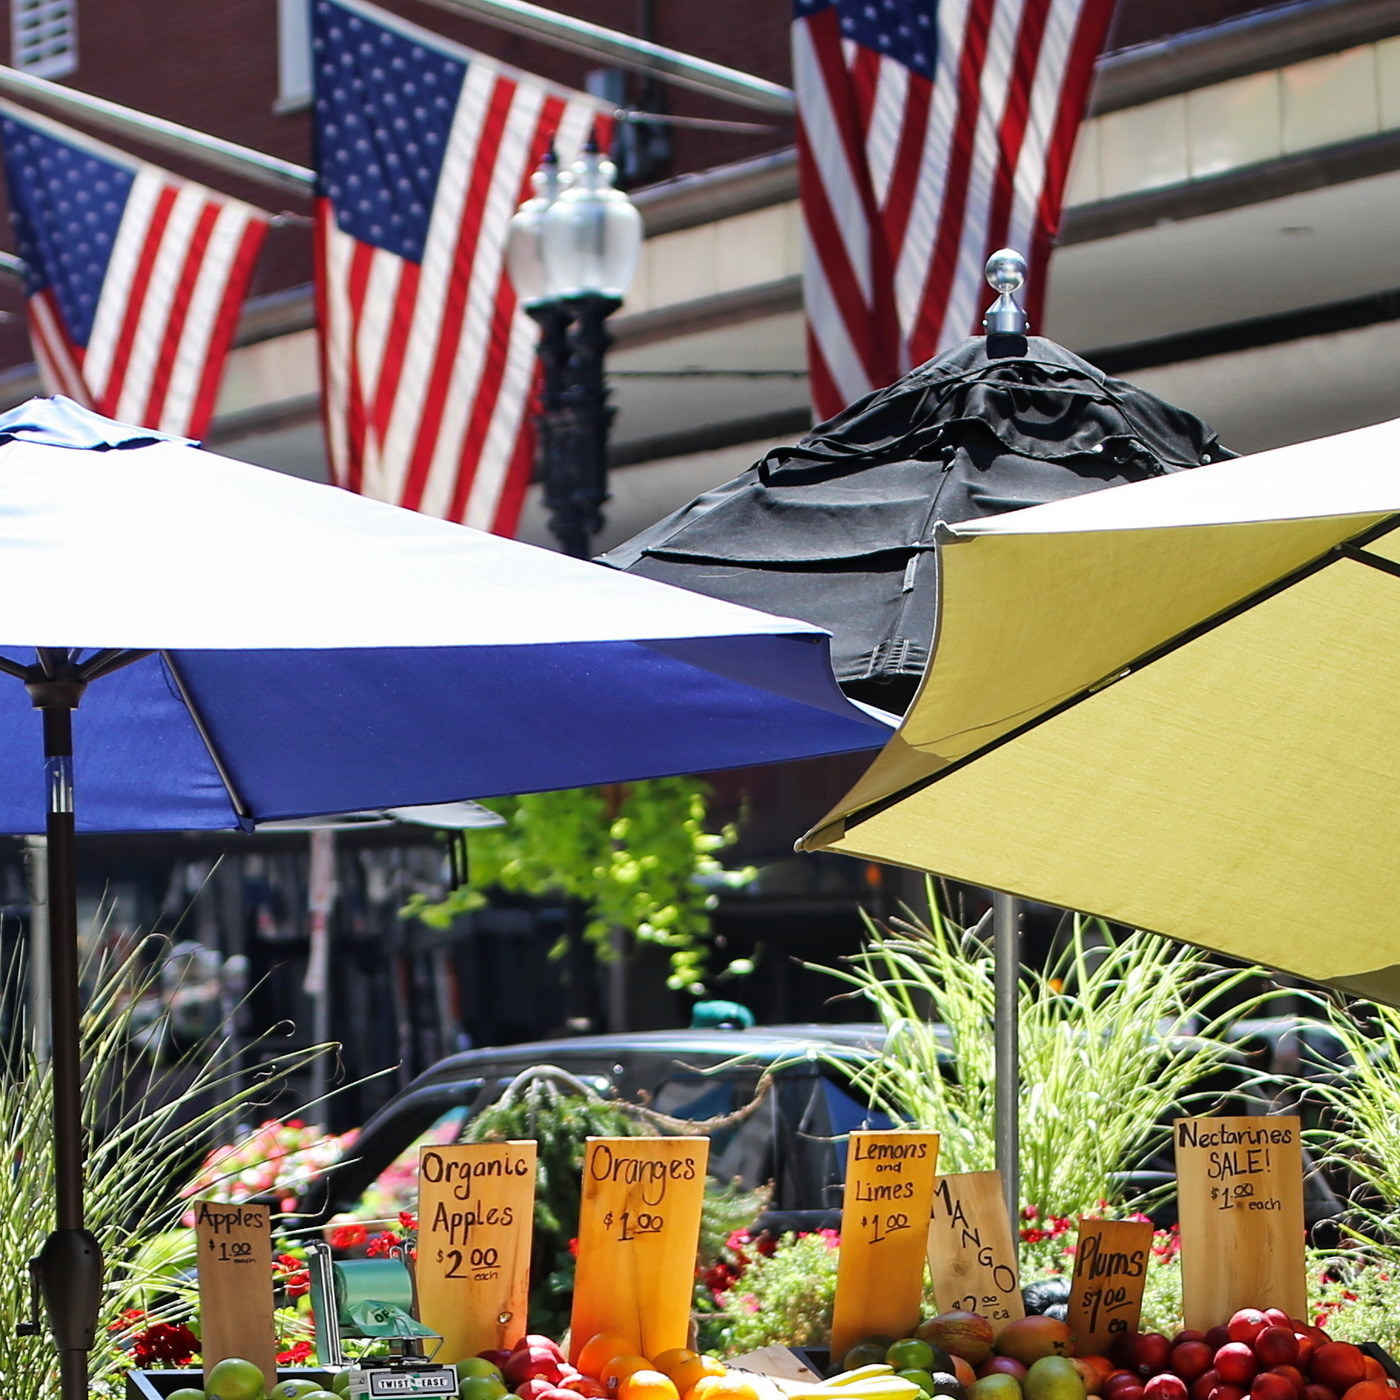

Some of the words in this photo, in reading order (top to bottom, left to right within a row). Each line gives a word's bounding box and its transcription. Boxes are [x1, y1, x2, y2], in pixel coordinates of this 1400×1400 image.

[1178, 1121, 1293, 1149] Nectarines
[855, 1137, 928, 1161] Lemons
[422, 1152, 528, 1200] Organic
[591, 1144, 695, 1206] Oranges
[876, 1161, 902, 1173] and
[1207, 1148, 1271, 1181] SALE!
[856, 1180, 914, 1202] Limes
[1248, 1198, 1281, 1211] each
[198, 1203, 264, 1235] Apples
[432, 1200, 514, 1246] Apples
[1077, 1232, 1144, 1280] Plums
[474, 1271, 498, 1281] each
[993, 1309, 1010, 1320] ea
[380, 1380, 409, 1389] TWIST
